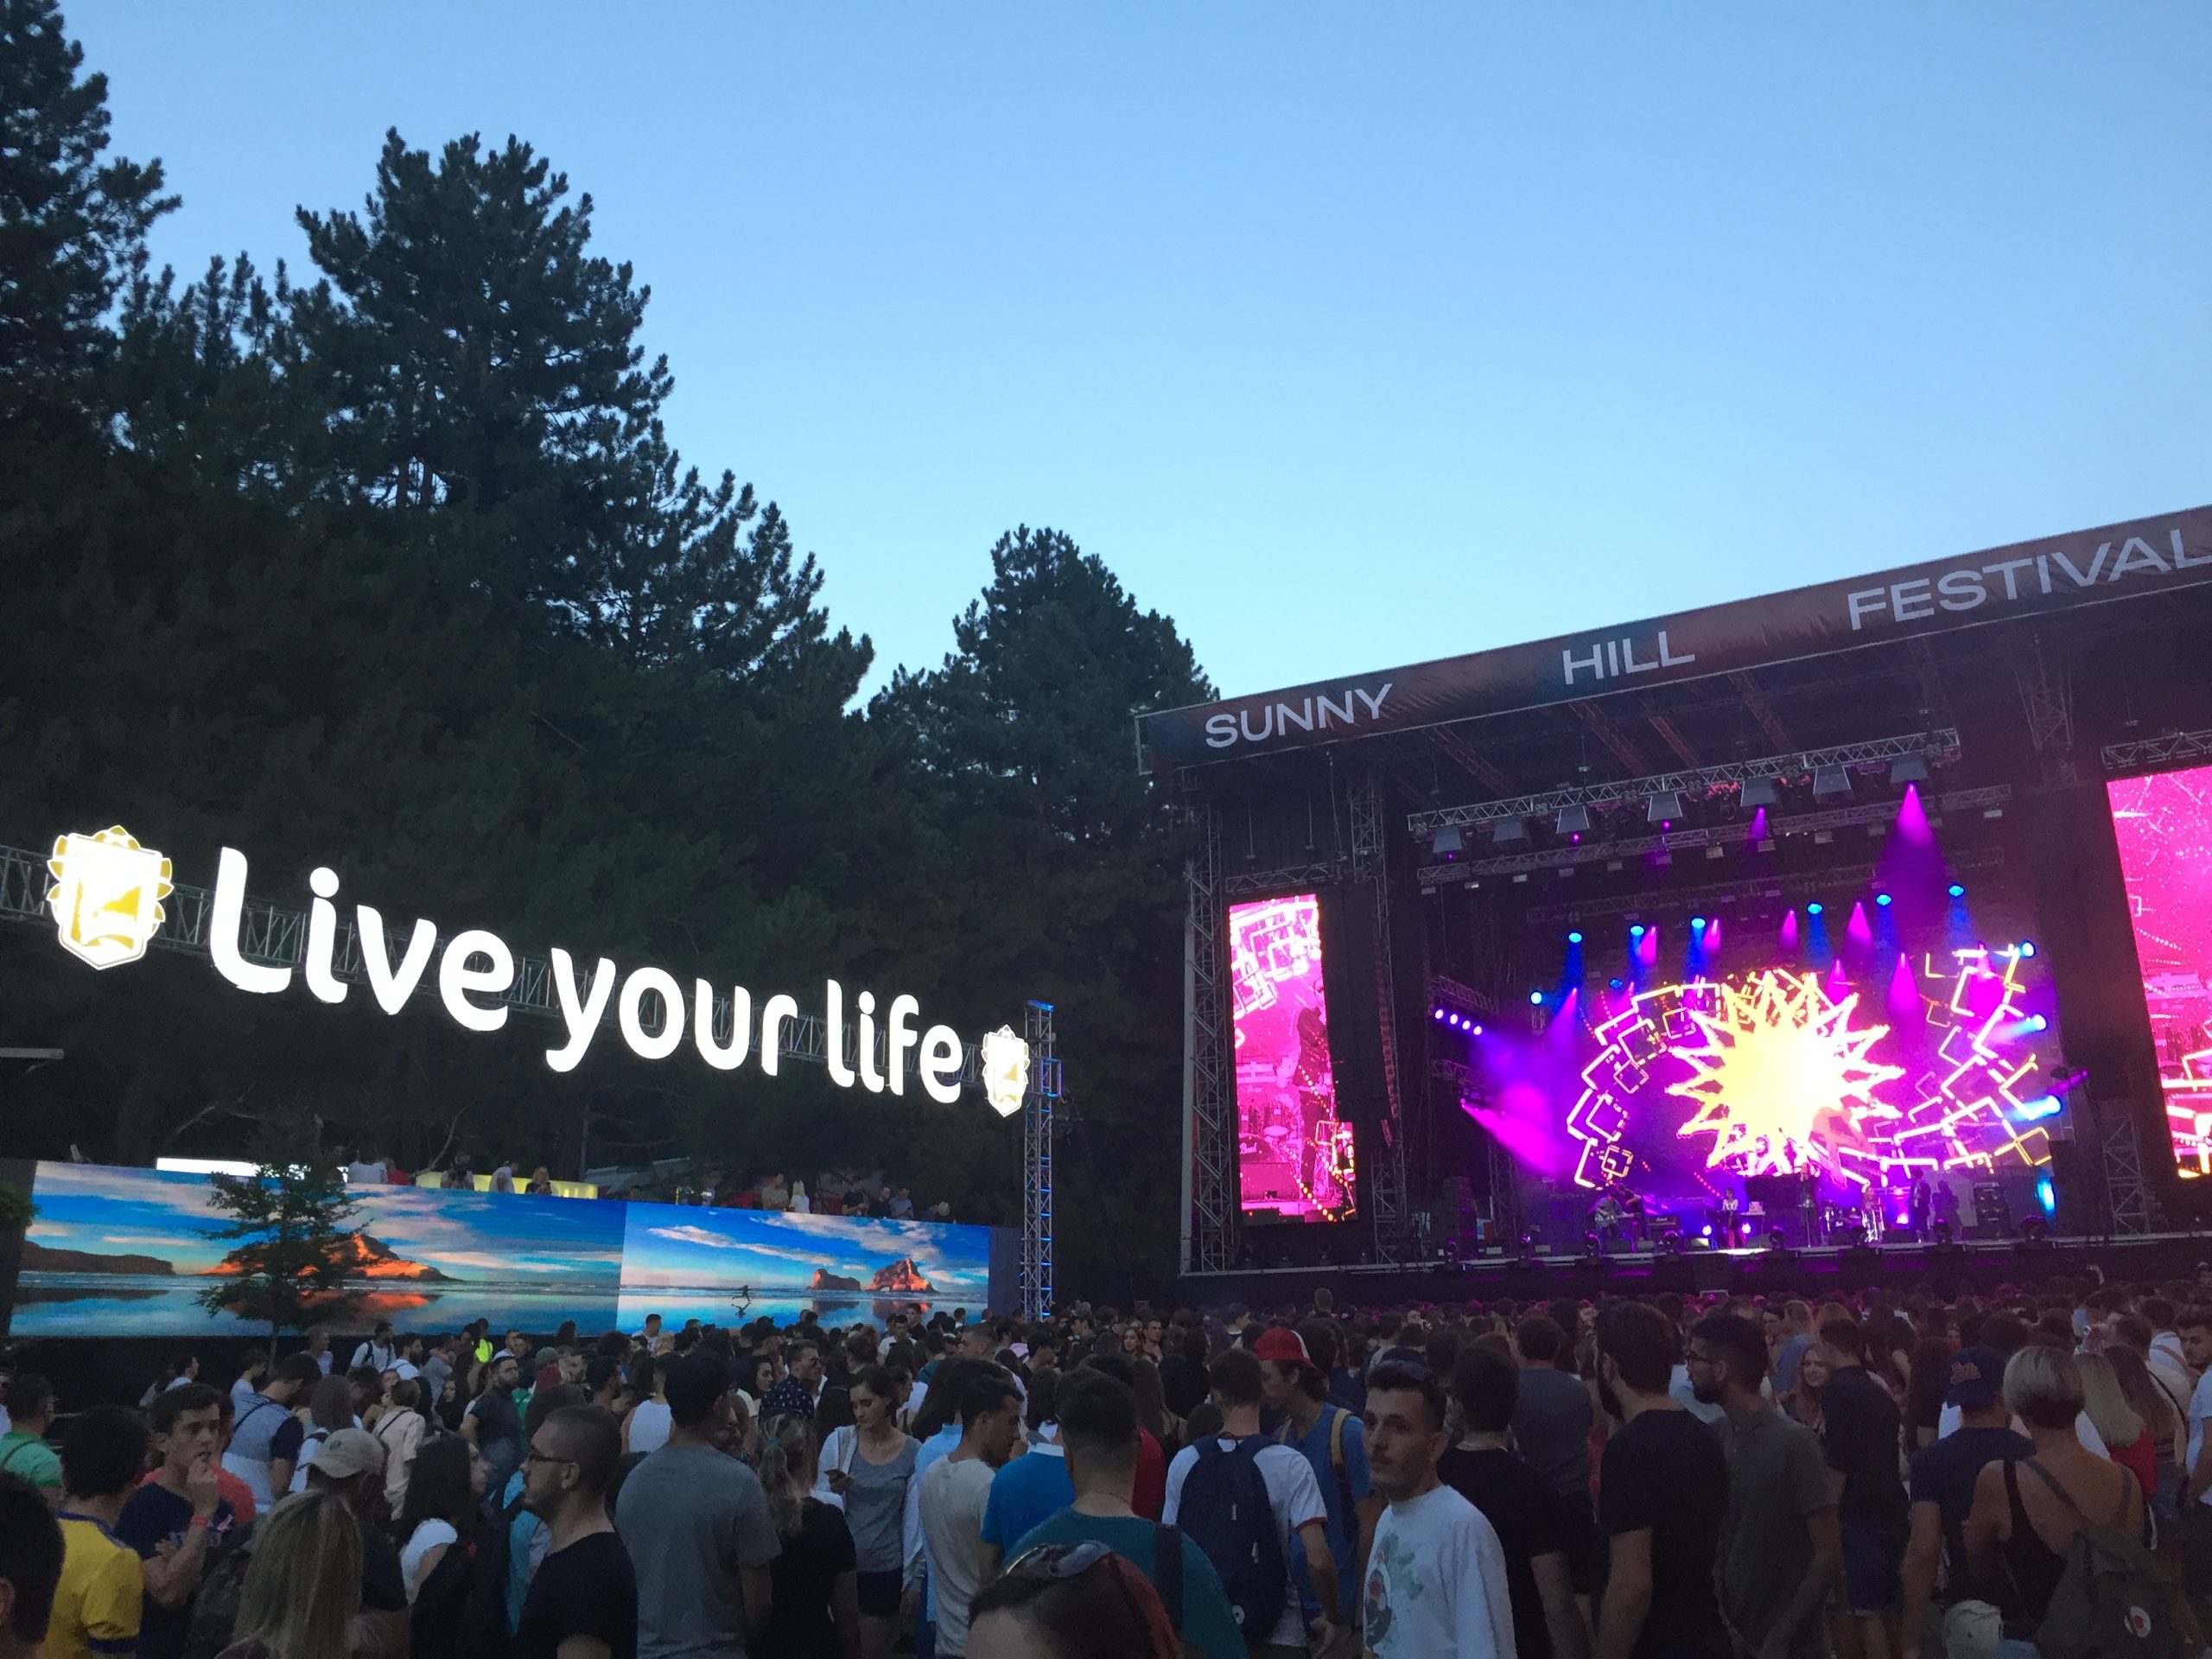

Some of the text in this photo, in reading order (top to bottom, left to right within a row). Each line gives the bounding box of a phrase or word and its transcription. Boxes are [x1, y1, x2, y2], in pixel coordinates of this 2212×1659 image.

[1205, 529, 2212, 749] SUNNY HILL FESTIVAL
[209, 846, 963, 1103] Live your life
